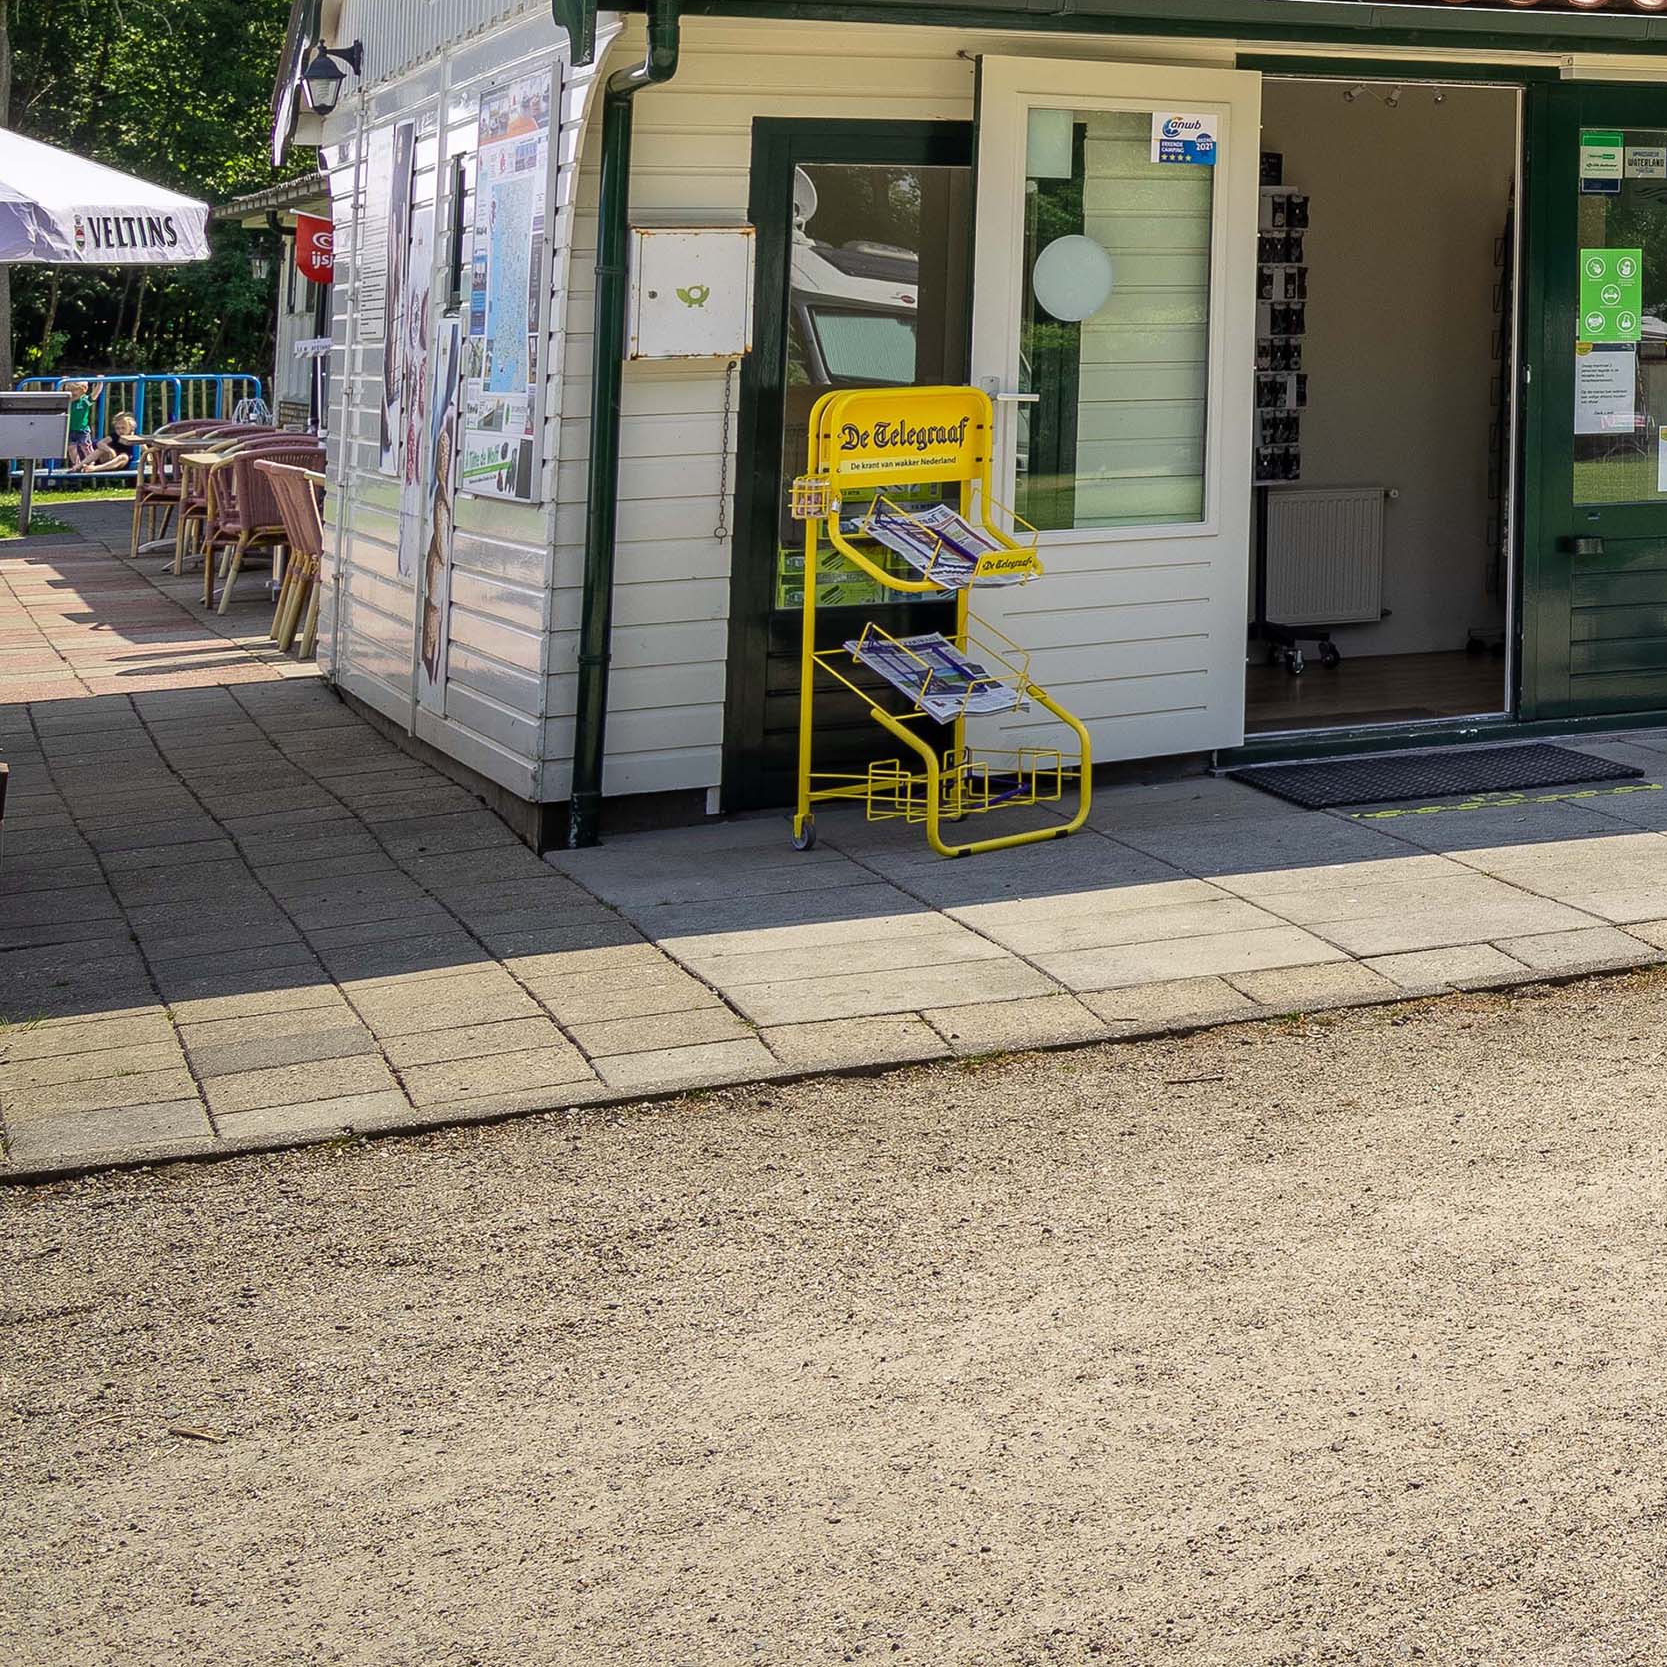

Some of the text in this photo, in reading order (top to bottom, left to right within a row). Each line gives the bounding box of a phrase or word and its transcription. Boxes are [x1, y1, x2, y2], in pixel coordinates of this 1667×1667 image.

[1170, 120, 1201, 130] anwb
[1196, 143, 1213, 151] 2021
[1627, 158, 1665, 167] WATERLAND
[87, 216, 178, 248] VELTINS
[840, 416, 970, 451] De Telegraaf
[850, 456, 957, 470] De krant van wakker Nederland
